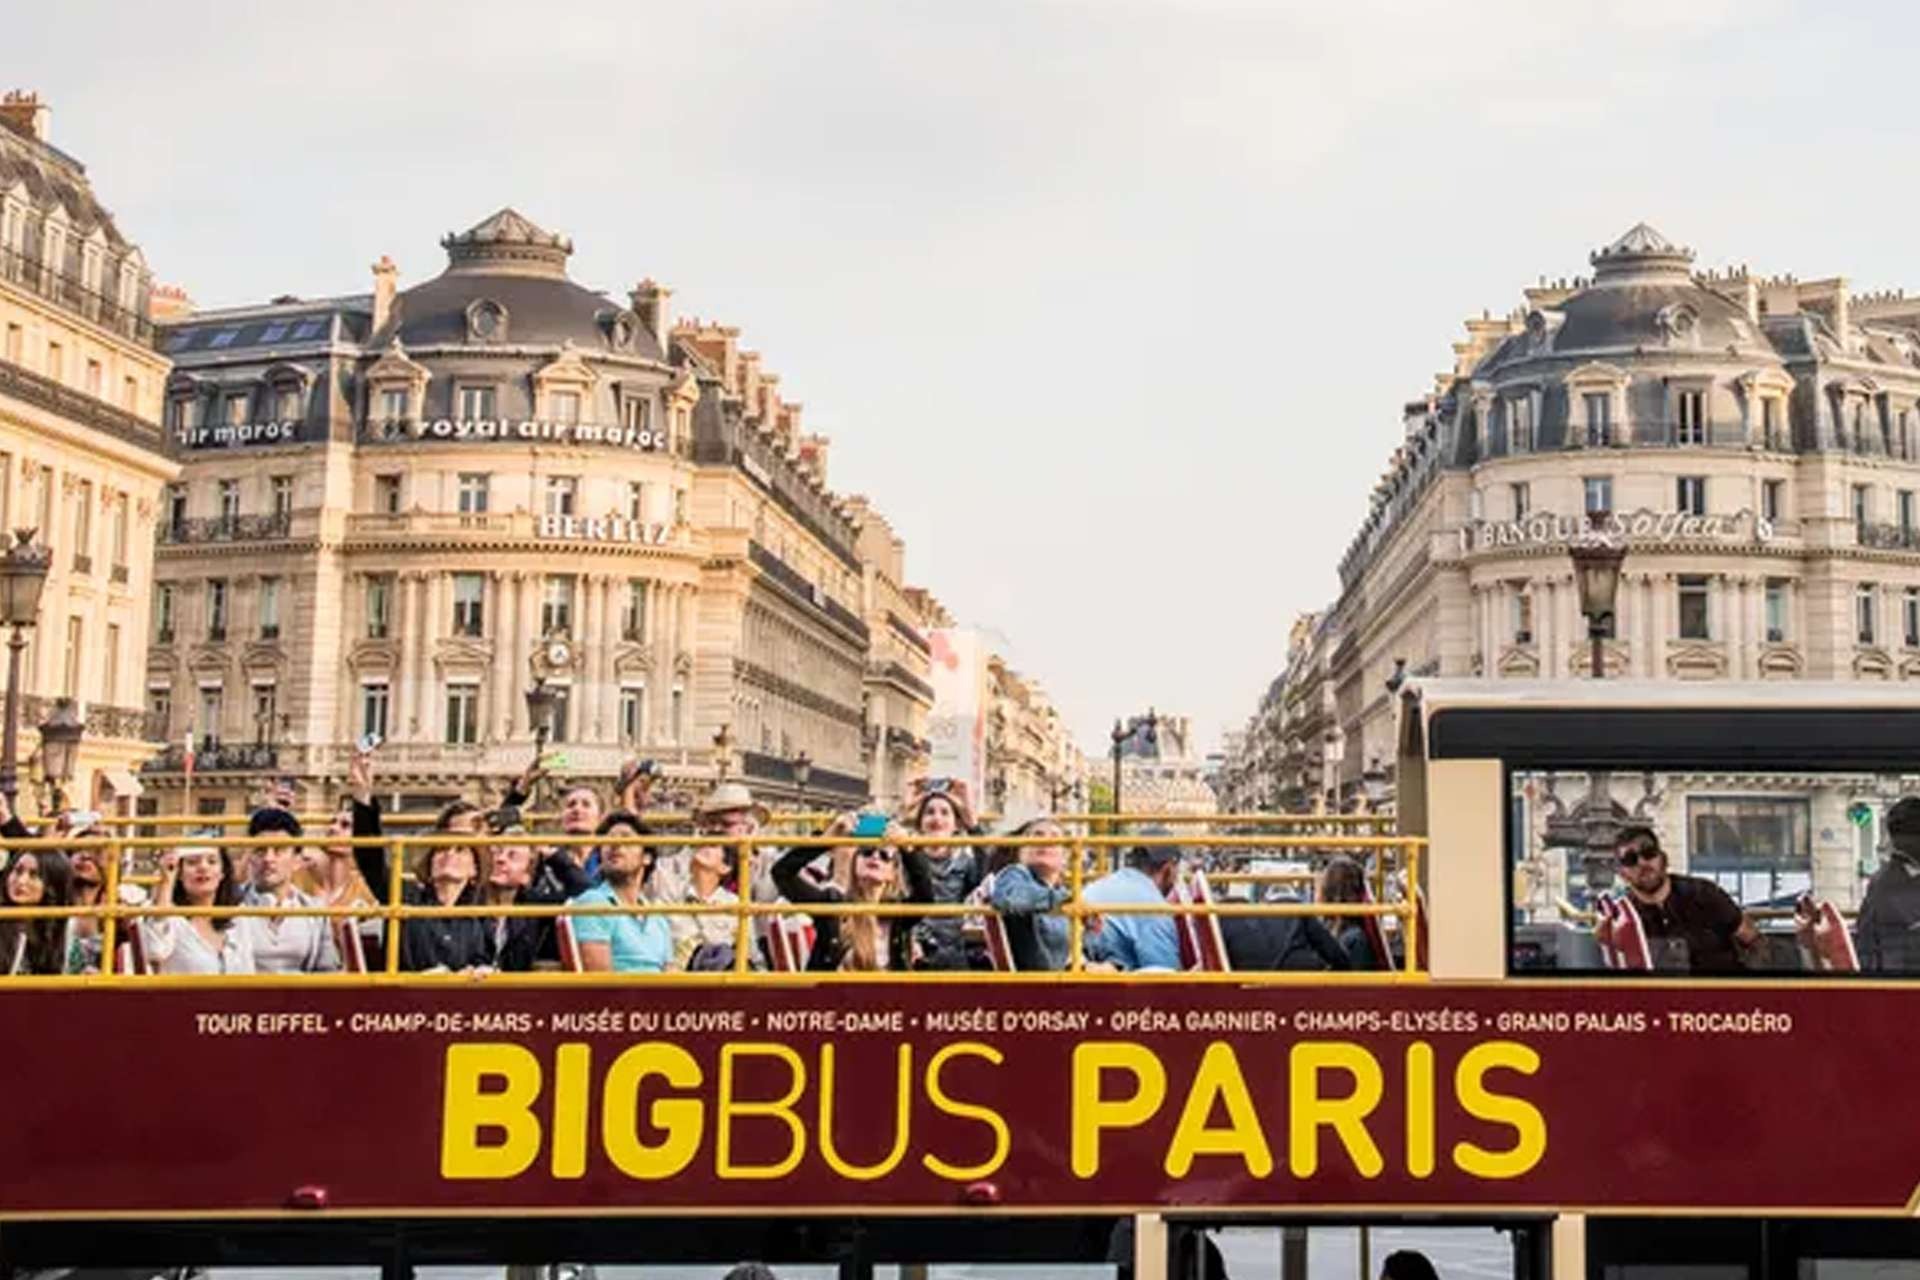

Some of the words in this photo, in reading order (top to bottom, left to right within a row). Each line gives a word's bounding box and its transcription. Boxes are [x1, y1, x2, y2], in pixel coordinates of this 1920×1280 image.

[214, 421, 295, 441] maroc
[416, 418, 509, 437] royal
[518, 418, 567, 440] air
[574, 422, 666, 449] maroc
[197, 1013, 252, 1033] TOUR
[257, 1013, 328, 1033] EIFFEL
[351, 1012, 532, 1032] CHAMP-DE-MARS
[552, 1008, 623, 1032] MUSÉE
[629, 1012, 659, 1032] DU
[664, 1011, 743, 1032] LOUVRE
[767, 1011, 903, 1031] NOTRE-DAME
[926, 1008, 997, 1031] MUSÉE
[1003, 1011, 1089, 1031] D'ORSAY
[1111, 1008, 1181, 1031] OPÉRA
[1185, 1011, 1276, 1031] GARNIER
[1294, 1008, 1478, 1032] CHAMPS-ELYSÉES
[1497, 1012, 1570, 1032] GRAND
[1575, 1012, 1646, 1032] PALAIS
[1668, 1009, 1792, 1033] TROCADÉRO
[1071, 1041, 1547, 1179] PARIS
